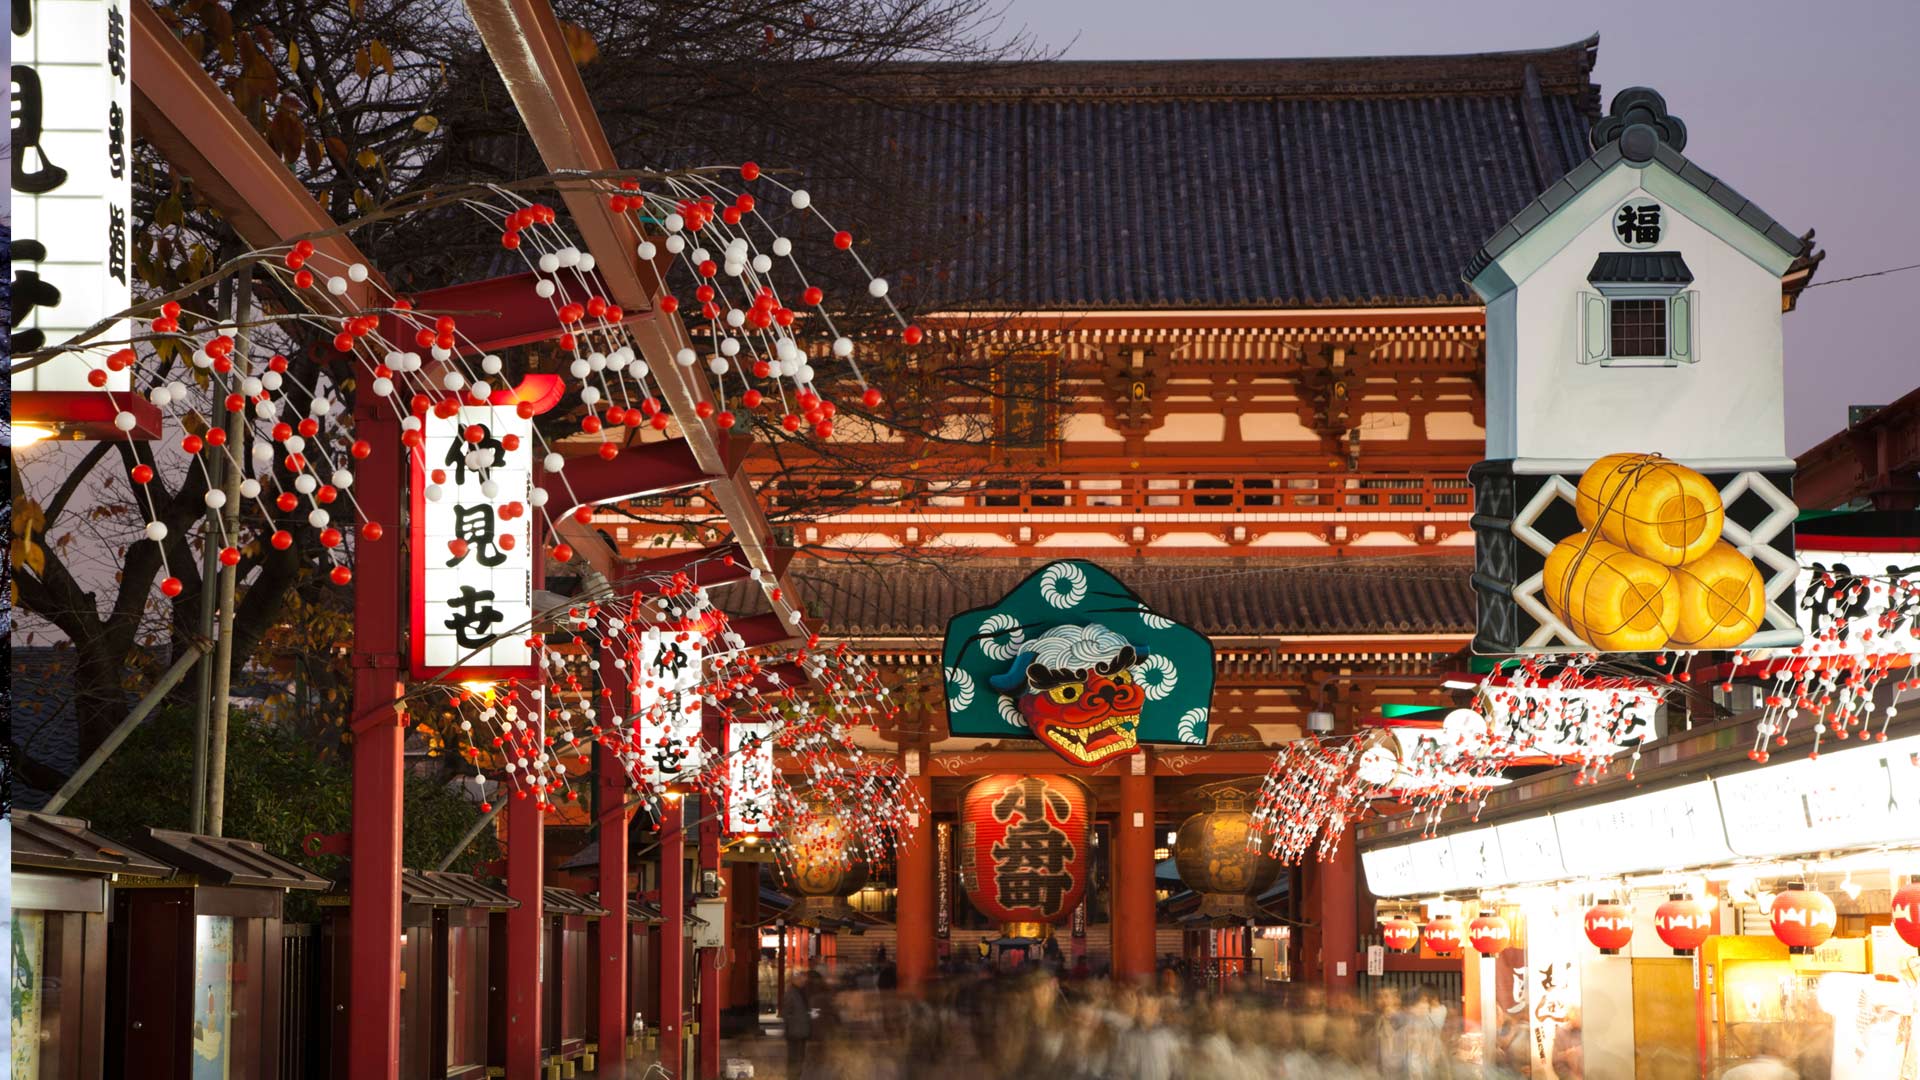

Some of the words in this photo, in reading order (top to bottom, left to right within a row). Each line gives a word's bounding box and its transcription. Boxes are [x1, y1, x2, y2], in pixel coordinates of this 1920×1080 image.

[1617, 204, 1660, 243] 福
[444, 423, 507, 650] 仲見世
